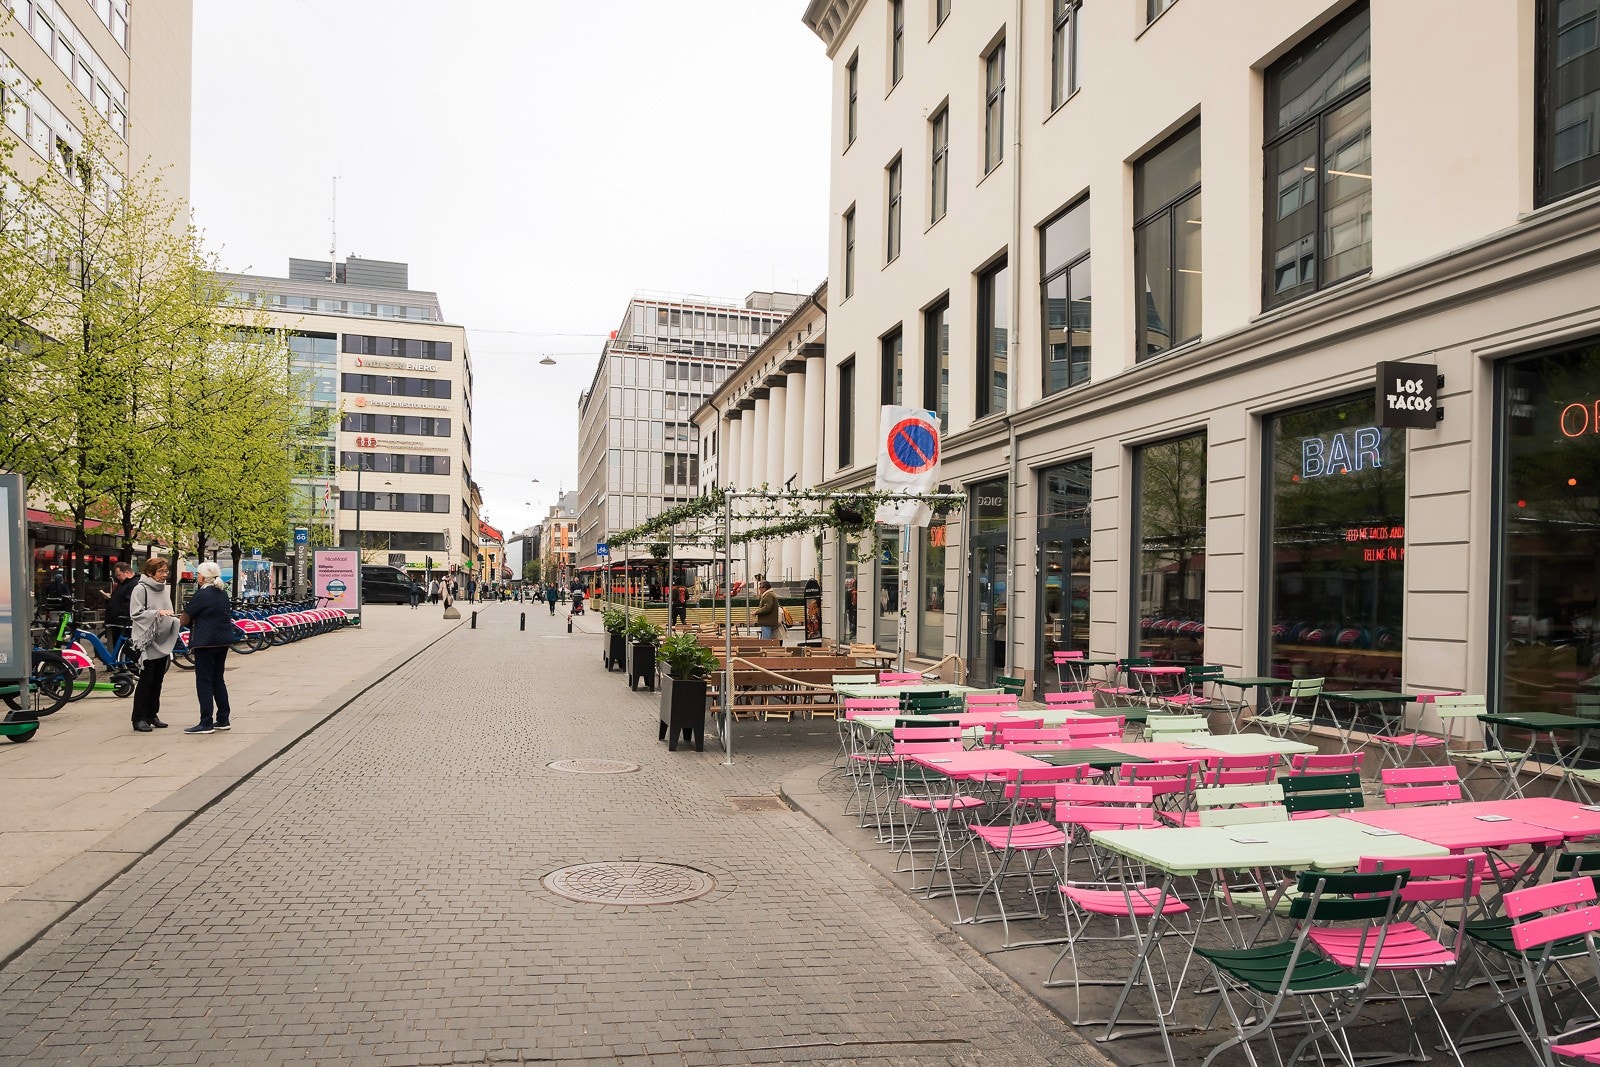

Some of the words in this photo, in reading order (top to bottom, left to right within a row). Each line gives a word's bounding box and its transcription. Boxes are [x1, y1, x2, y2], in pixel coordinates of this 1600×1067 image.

[406, 363, 438, 372] ENERGI
[1396, 378, 1424, 394] LOS
[1386, 394, 1433, 411] TACOS
[1302, 427, 1382, 478] BAR
[1345, 529, 1358, 542] FEED
[1359, 527, 1368, 540] ME
[1369, 527, 1388, 540] TACOS
[1389, 526, 1404, 538] AND
[1363, 548, 1375, 561] TELL
[1376, 548, 1385, 561] ME
